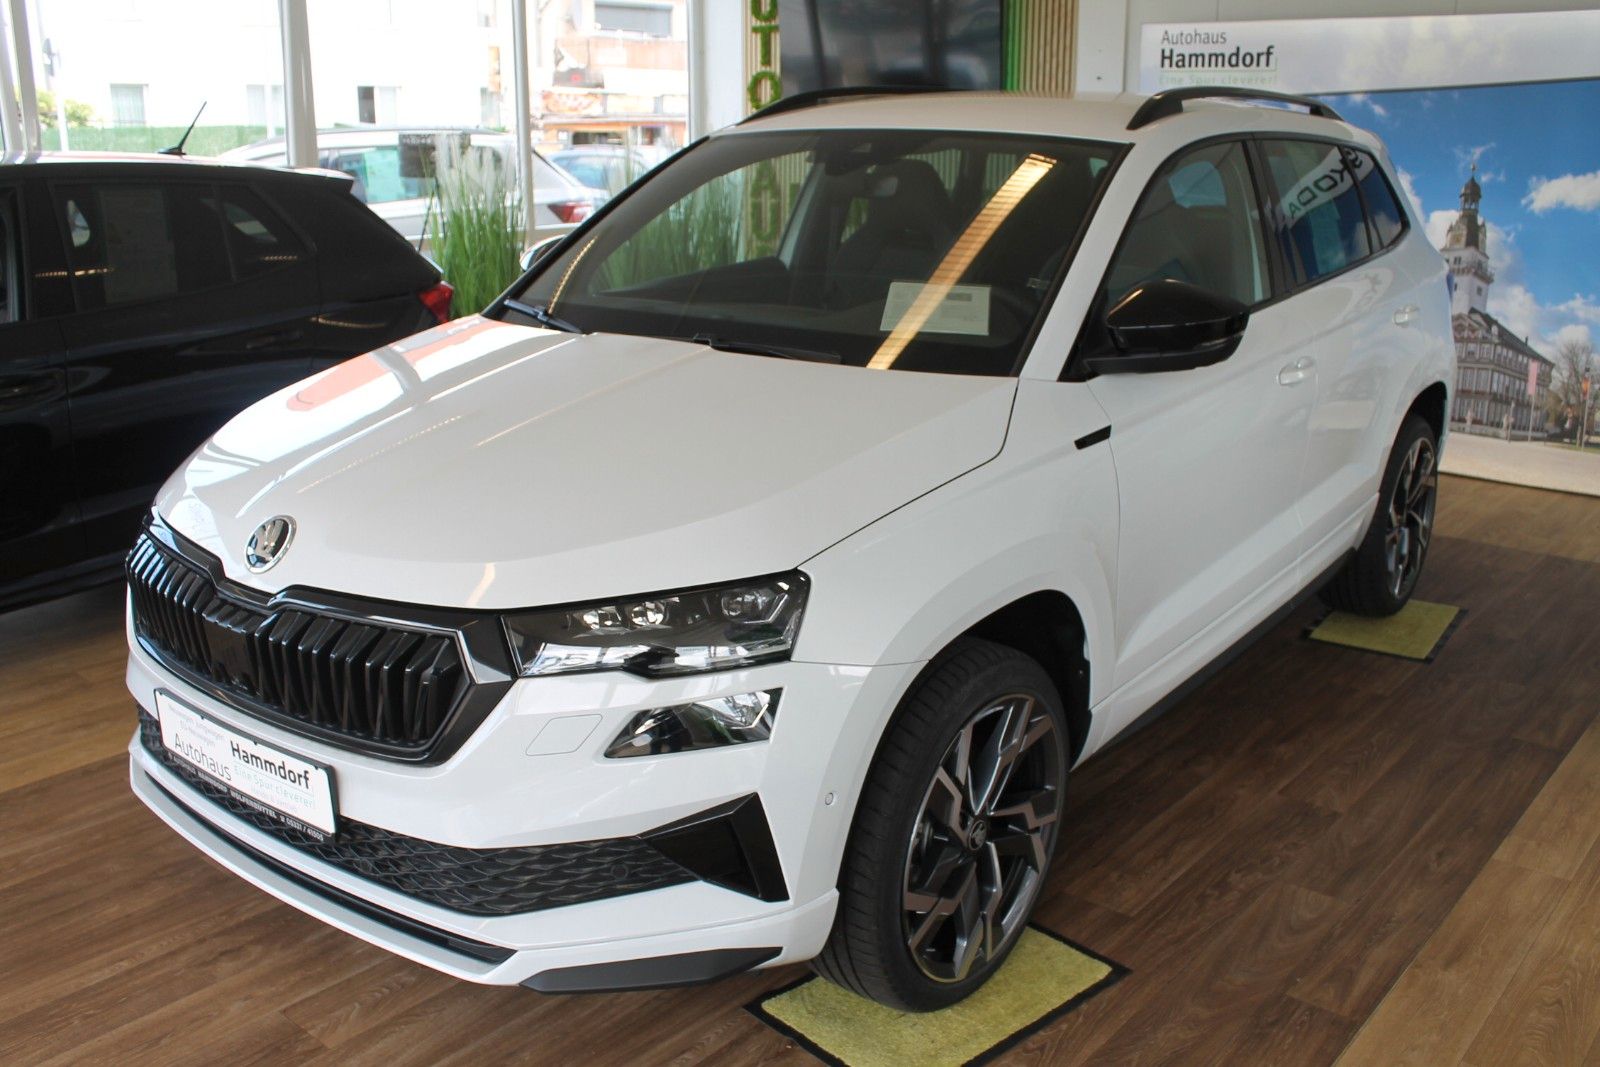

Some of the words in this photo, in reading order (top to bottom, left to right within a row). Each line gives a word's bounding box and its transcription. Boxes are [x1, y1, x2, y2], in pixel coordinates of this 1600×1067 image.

[1161, 28, 1227, 45] Autohaus
[1160, 44, 1275, 68] Hammdorf
[1159, 75, 1184, 85] Eine
[1190, 74, 1216, 86] Spur
[175, 732, 232, 781] Autohaus
[230, 740, 310, 790] Hammdorf
